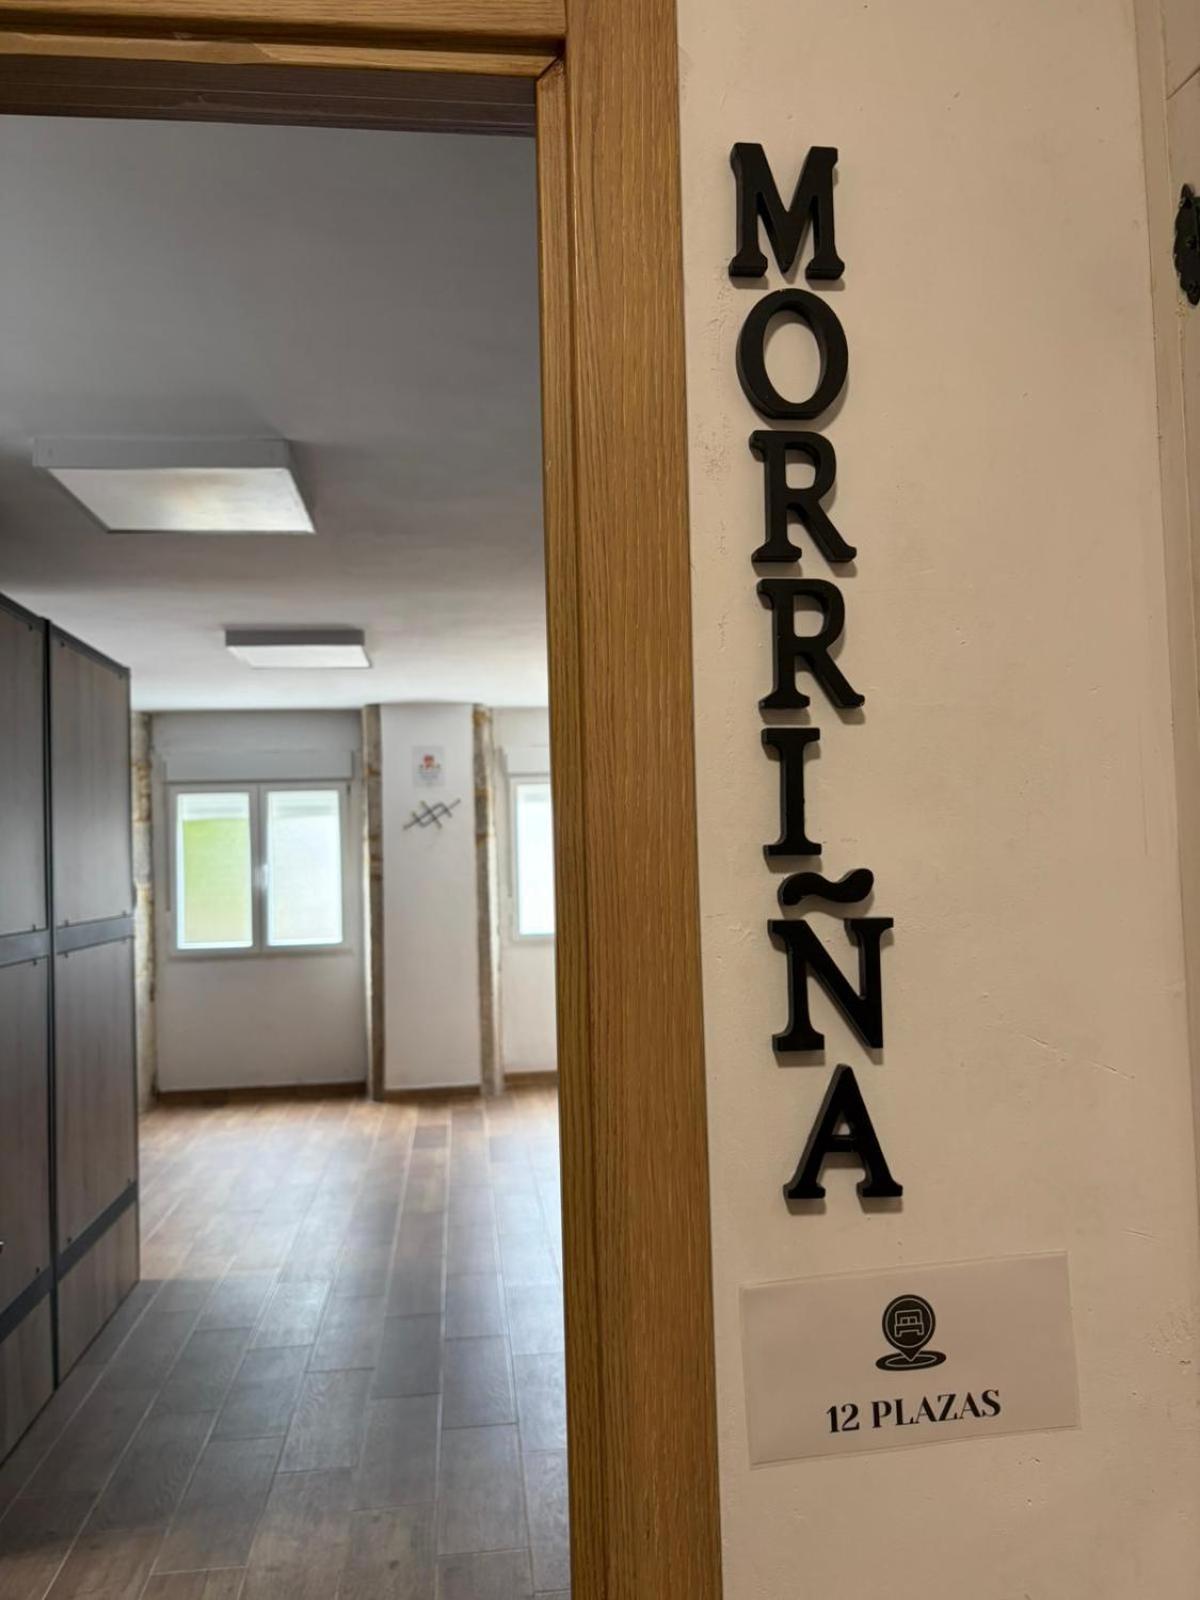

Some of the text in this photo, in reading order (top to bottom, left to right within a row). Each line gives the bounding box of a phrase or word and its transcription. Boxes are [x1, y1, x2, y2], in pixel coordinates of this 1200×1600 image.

[729, 142, 903, 1204] MORRIÑA
[826, 1389, 1001, 1433] 12 PLAZAS
